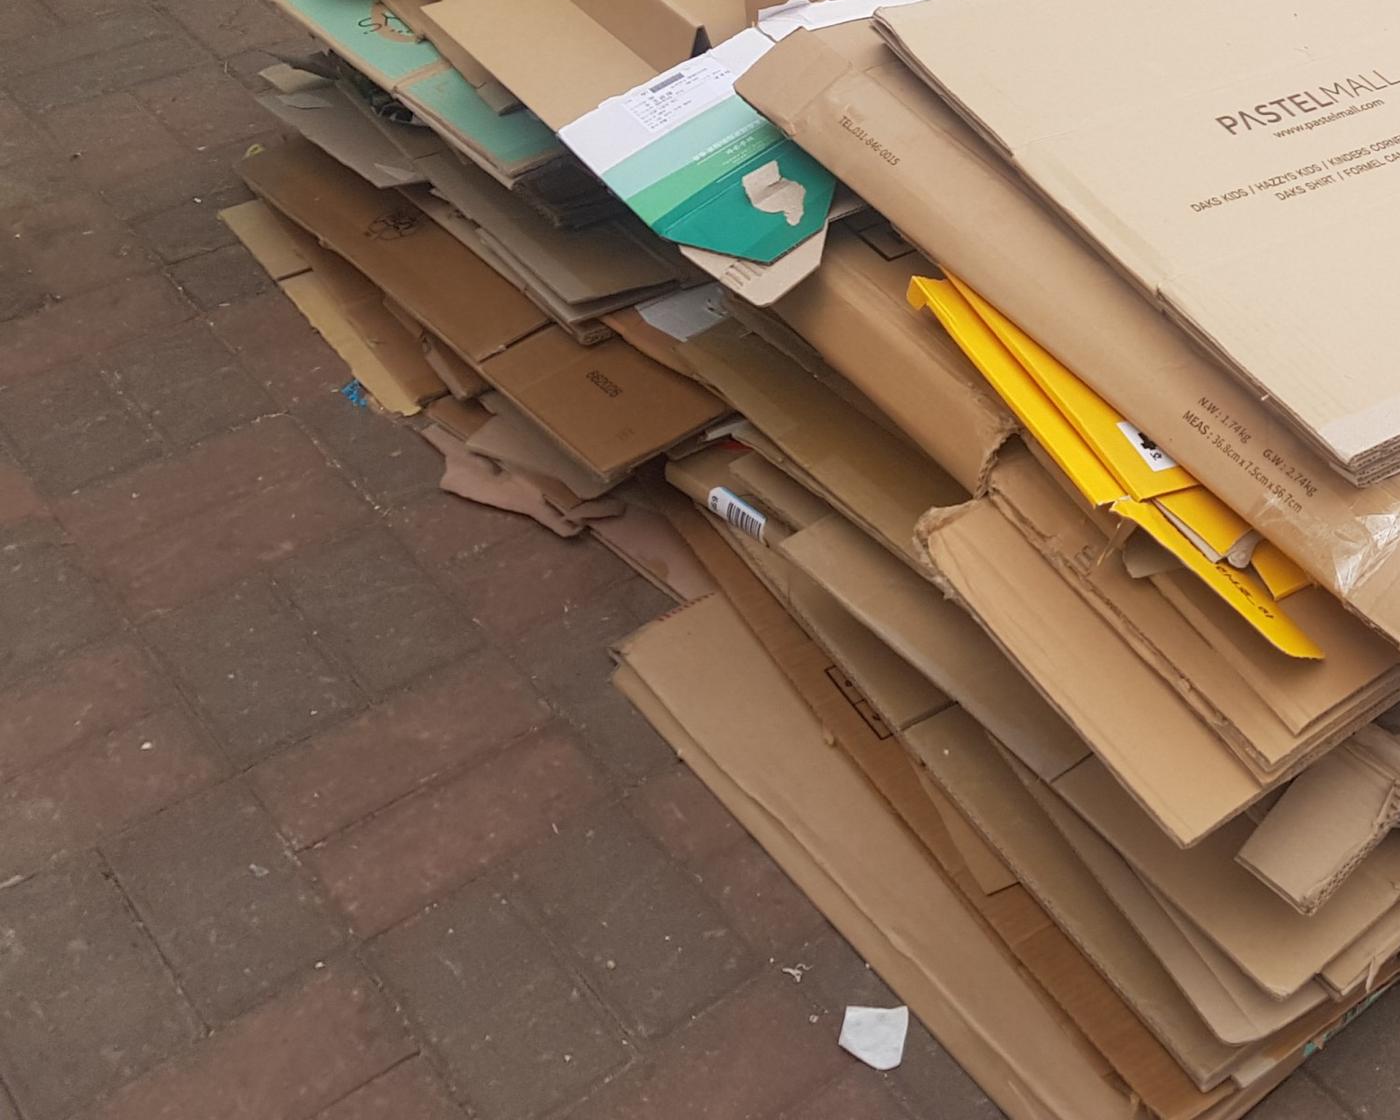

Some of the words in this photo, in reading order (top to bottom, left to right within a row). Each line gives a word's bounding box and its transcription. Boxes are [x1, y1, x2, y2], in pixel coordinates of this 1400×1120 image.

[1272, 97, 1385, 139] www.pastelmall.com
[1190, 196, 1223, 214] DAKS
[1220, 187, 1250, 203] KIDS
[1254, 172, 1299, 194] HAZZYS
[1296, 162, 1323, 179] KIDS
[1327, 146, 1372, 167] KINDERS
[1273, 184, 1307, 202] DAKS
[1306, 173, 1337, 192] SHIRT
[1342, 158, 1387, 179] FORMEL
